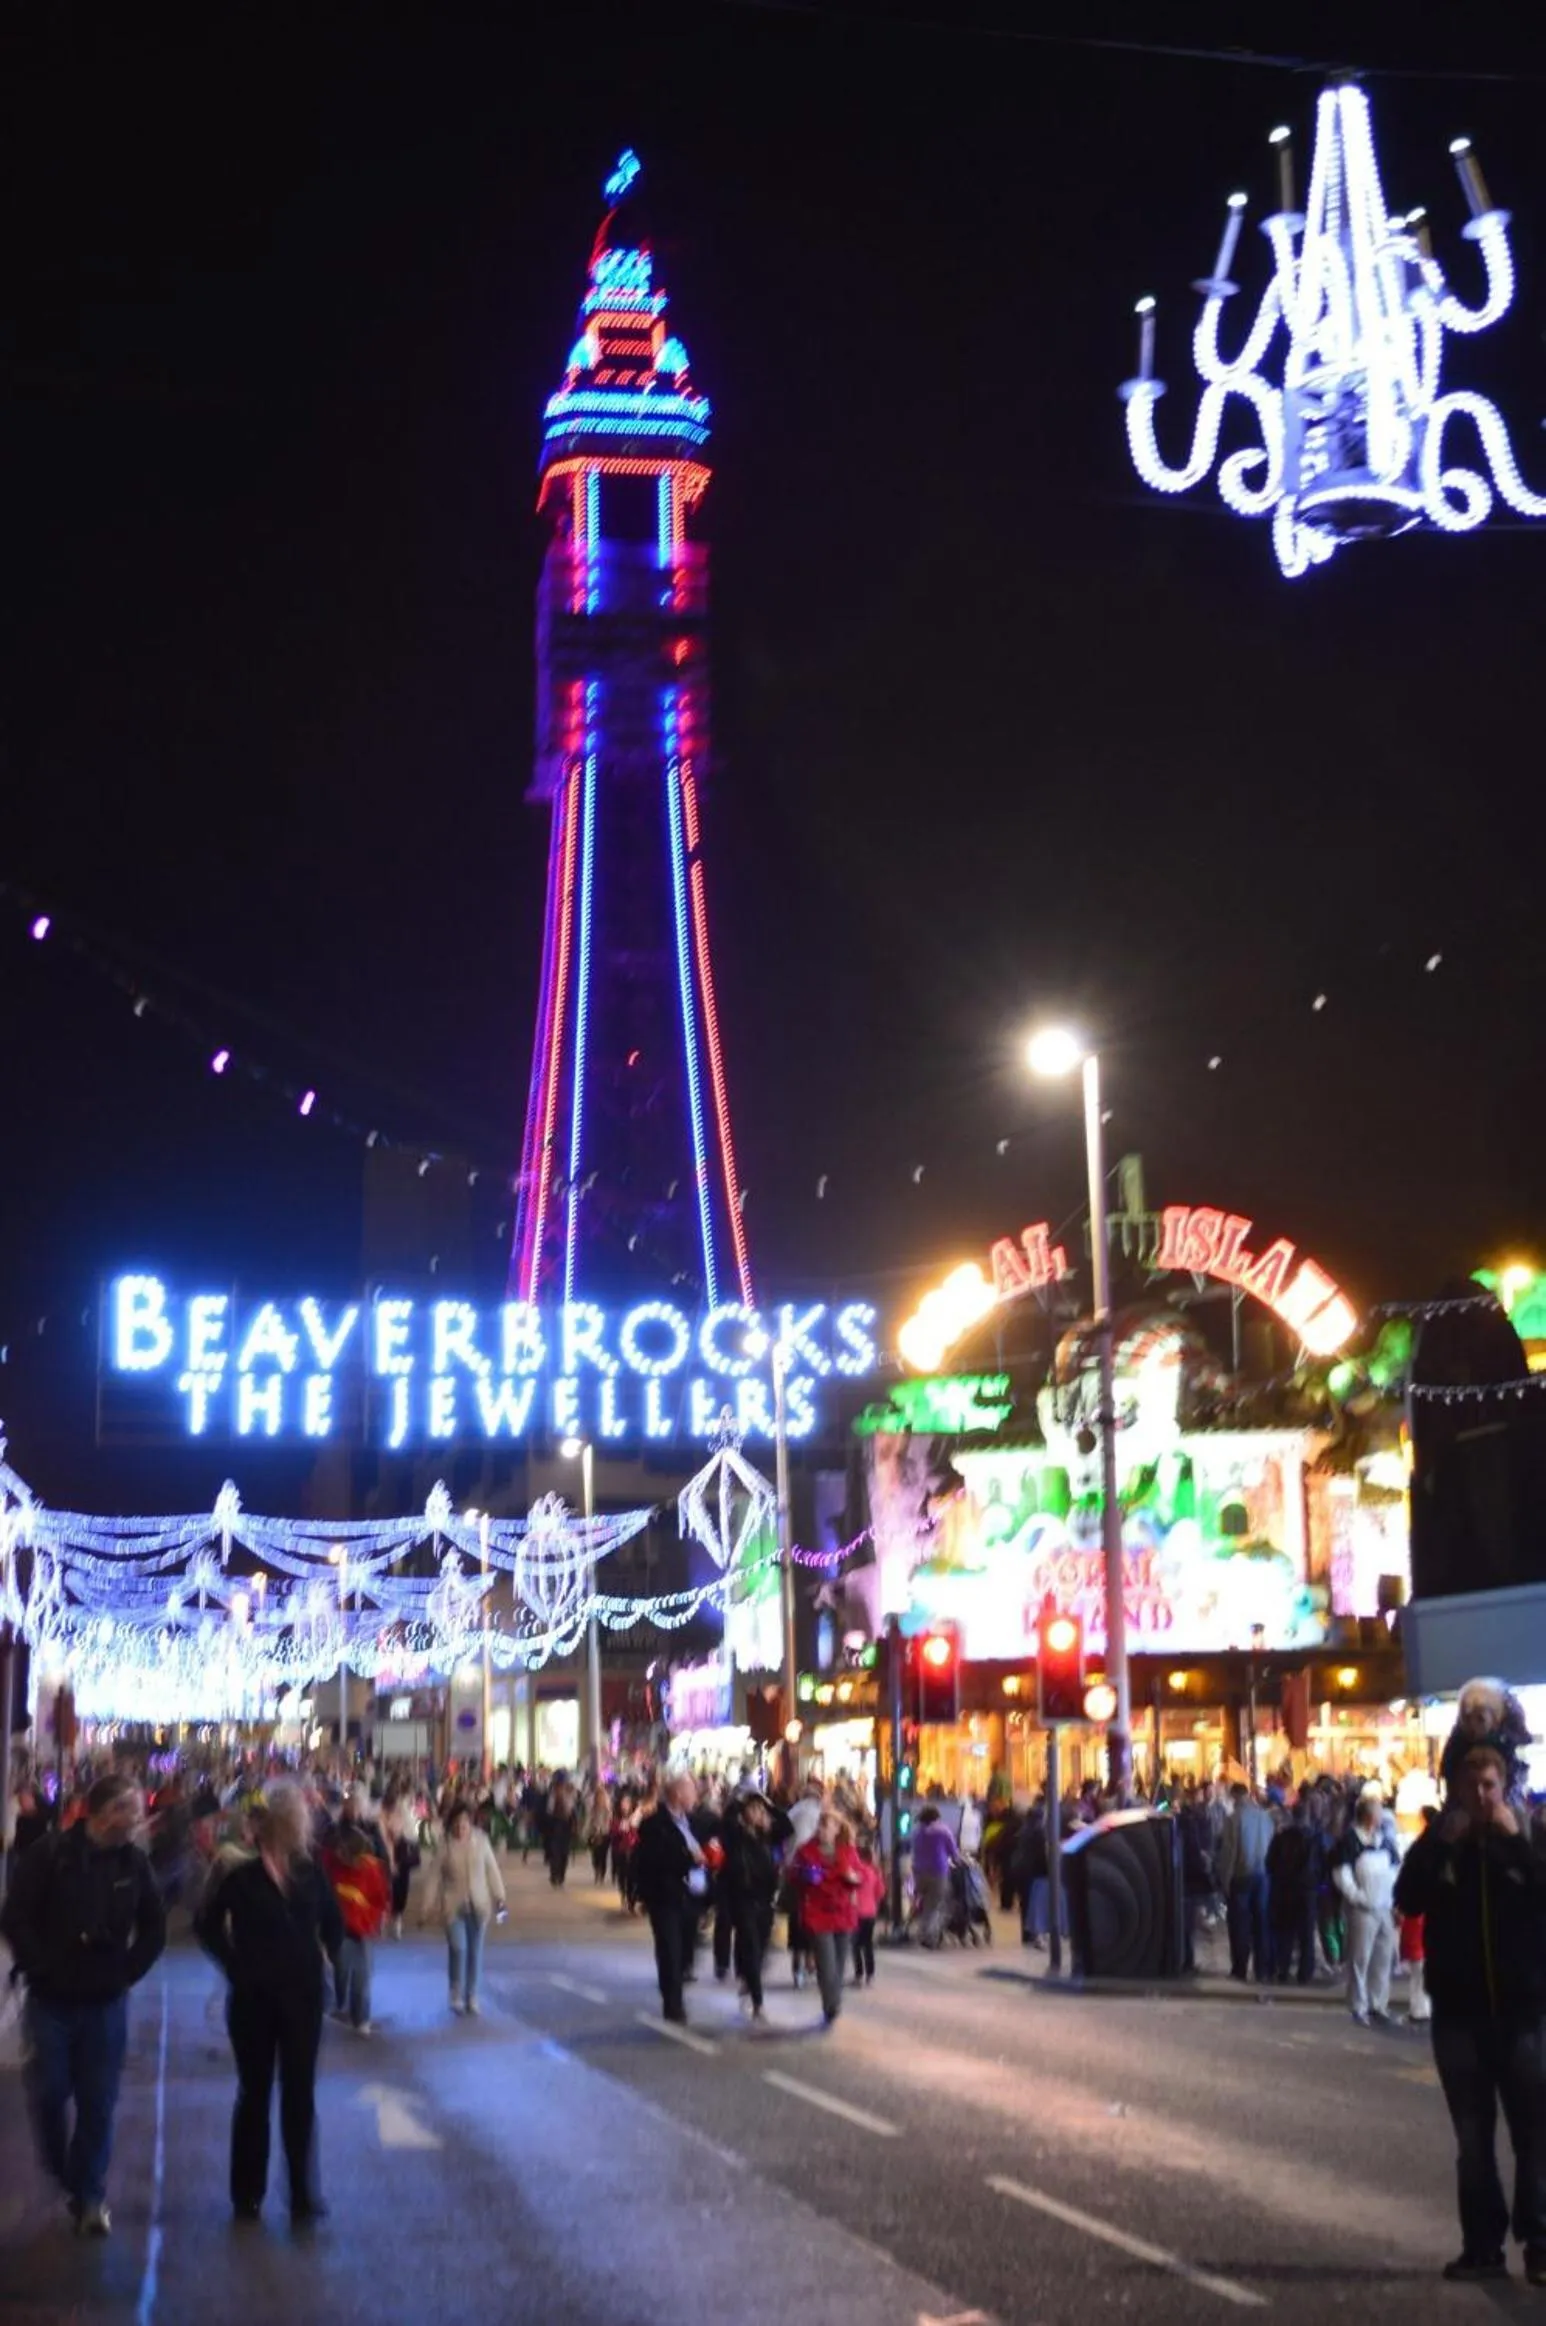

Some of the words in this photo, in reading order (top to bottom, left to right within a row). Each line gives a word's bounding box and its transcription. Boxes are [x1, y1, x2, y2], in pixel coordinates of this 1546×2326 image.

[114, 1274, 876, 1379] BEAVERBROOKS
[178, 1371, 333, 1436] THE
[388, 1375, 815, 1449] JEWELLERS
